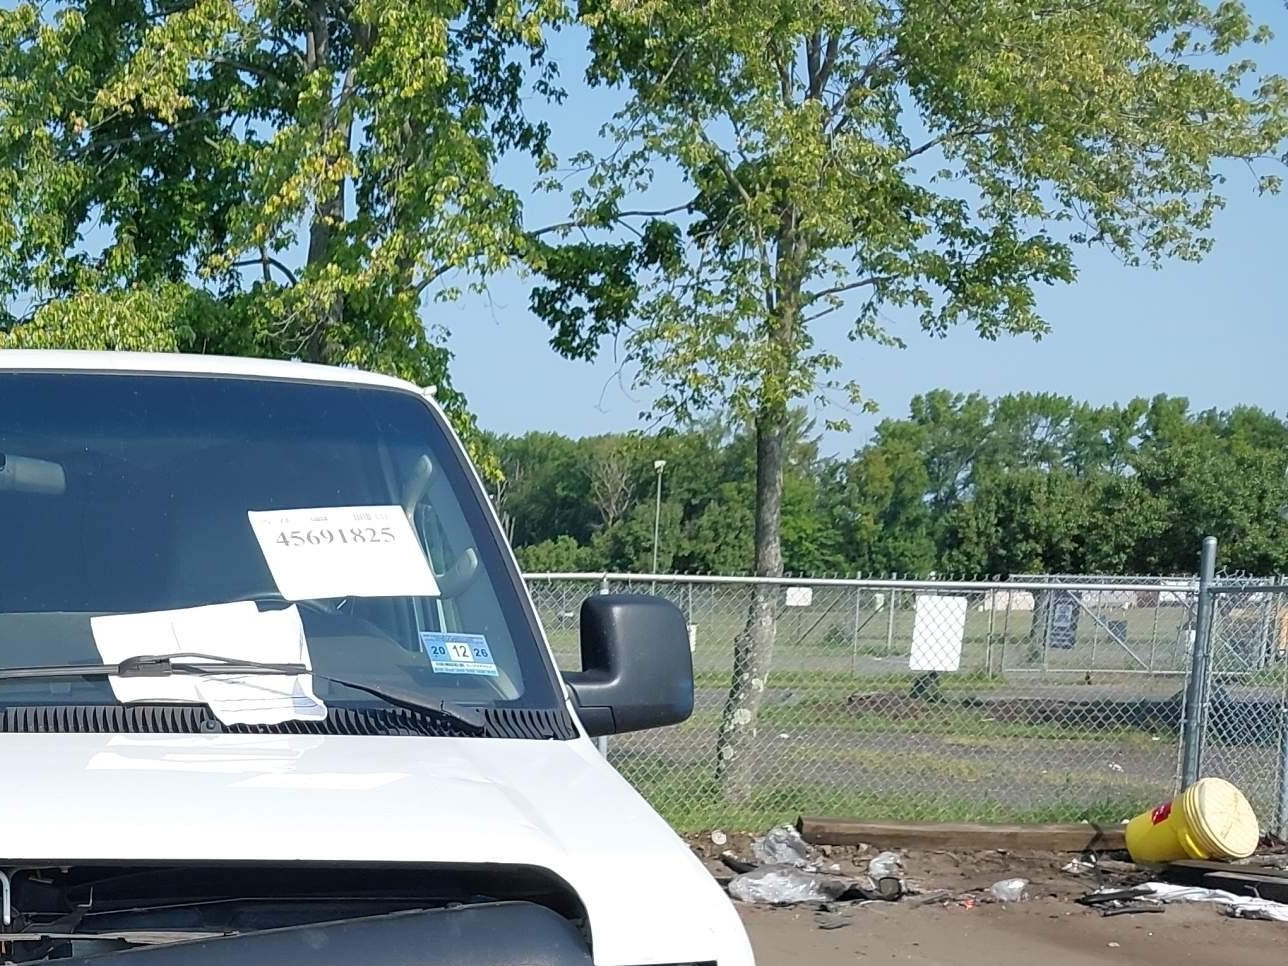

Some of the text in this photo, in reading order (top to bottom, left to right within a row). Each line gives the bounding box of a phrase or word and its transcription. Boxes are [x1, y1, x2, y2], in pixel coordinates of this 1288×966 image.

[275, 527, 396, 546] 45691825
[431, 645, 489, 658] 20 12 26
